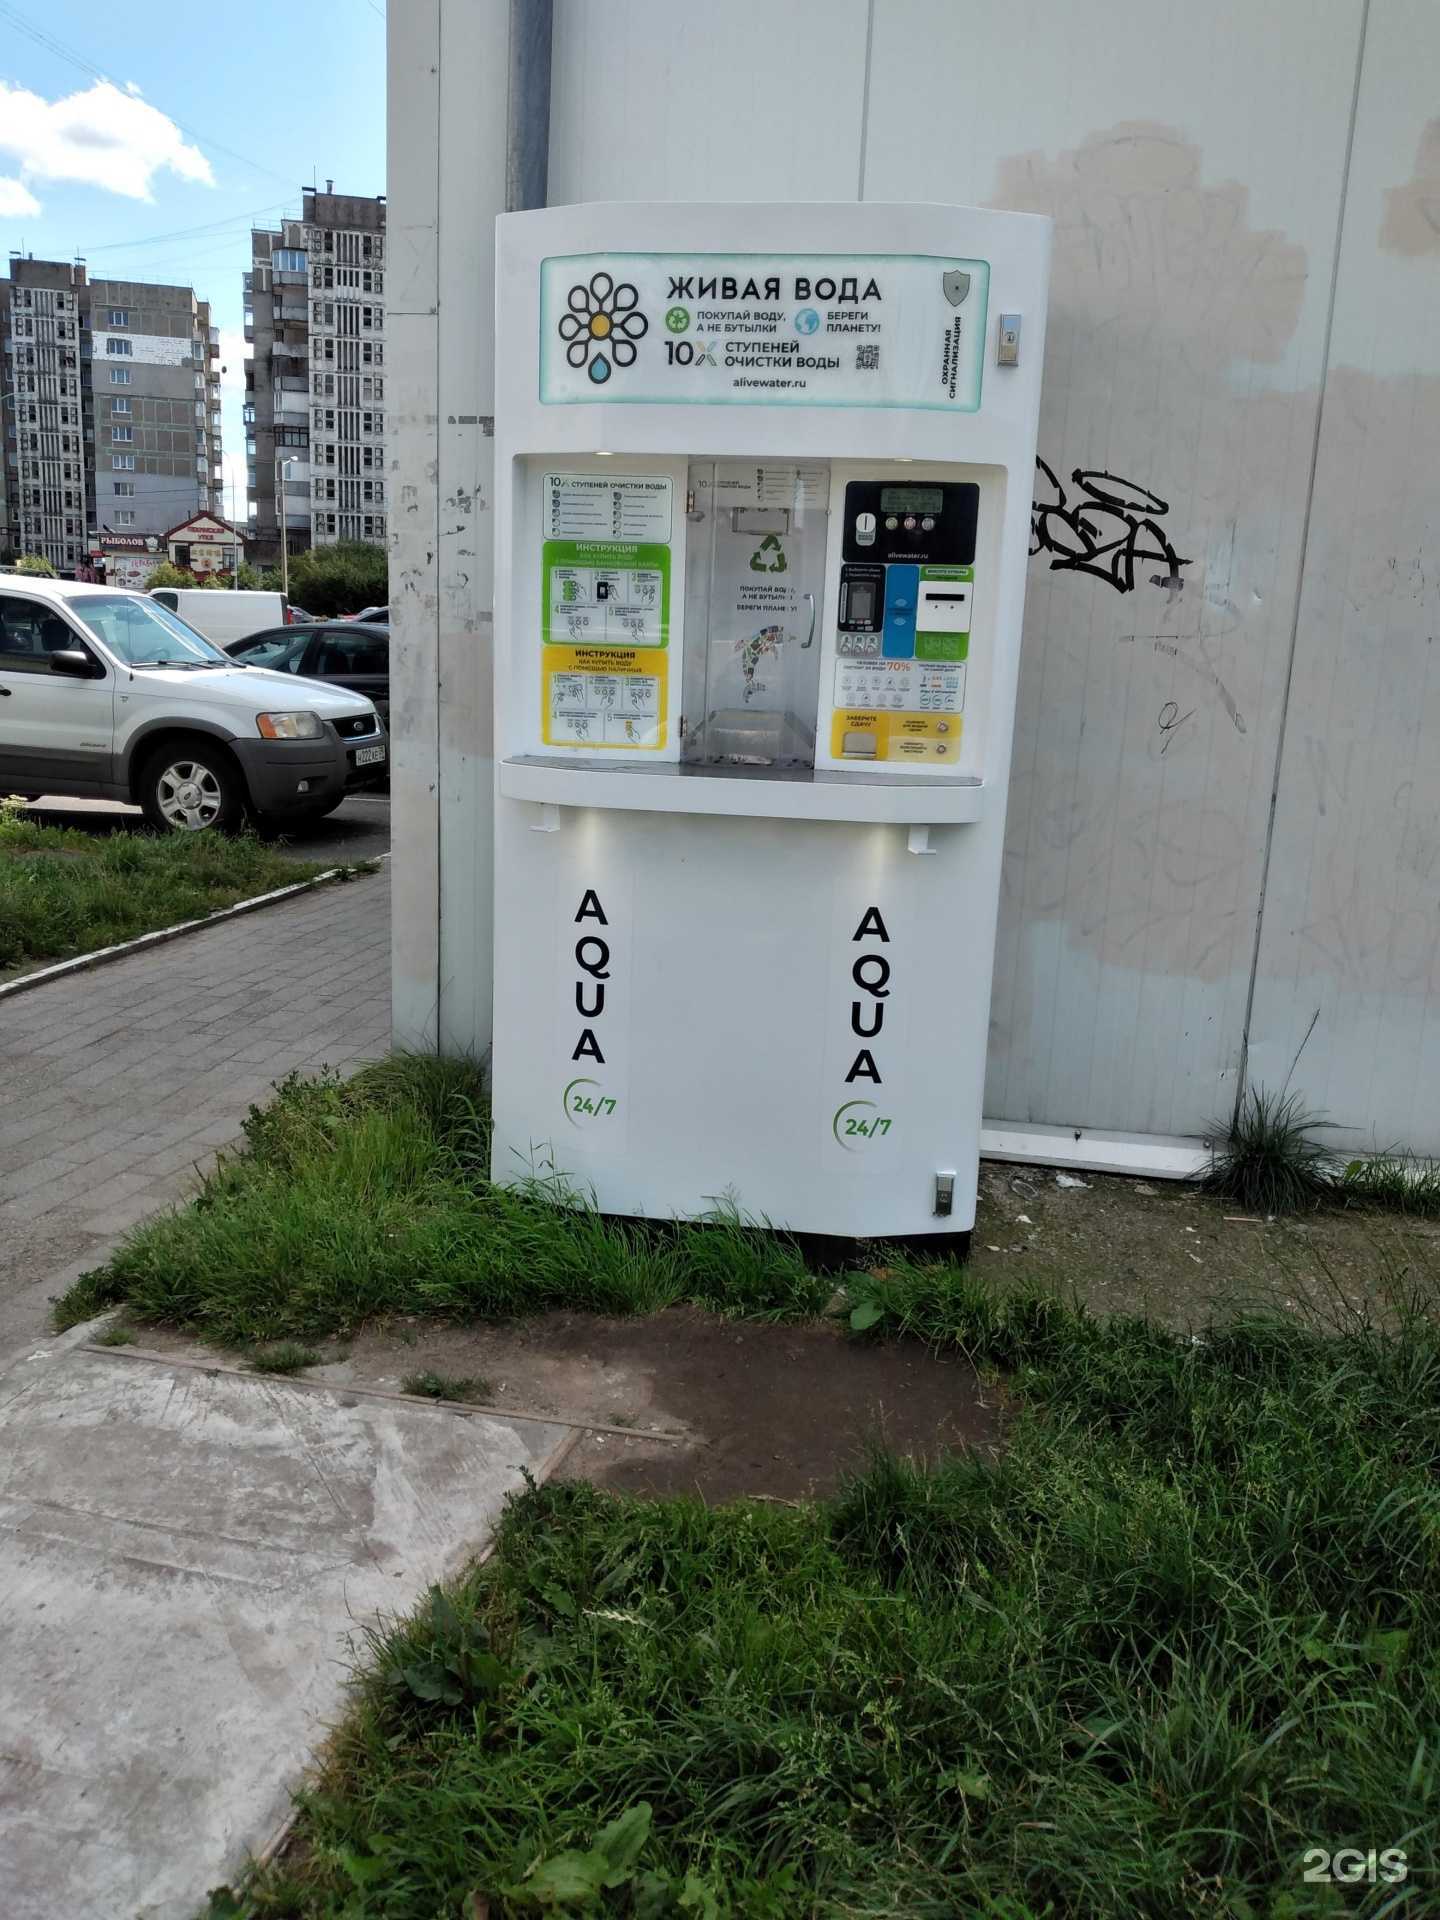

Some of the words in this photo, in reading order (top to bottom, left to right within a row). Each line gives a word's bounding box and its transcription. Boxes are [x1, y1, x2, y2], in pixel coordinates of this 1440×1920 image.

[666, 276, 781, 300] ЖИВАЯ
[794, 277, 882, 304] ВОДА
[697, 310, 751, 320] ПОКУПАЙ
[753, 311, 786, 322] ВОДУ,
[827, 311, 869, 321] БЕРЕГИ
[696, 324, 704, 332] А
[707, 324, 722, 333] НЕ
[724, 323, 777, 333] БУТЫЛКИ
[826, 323, 881, 333] ПЛАНЕТУ!
[725, 340, 800, 354] СТУПЕНЕЙ
[725, 356, 792, 368] ОЧИСТКИ
[796, 357, 840, 369] ВОДЫ
[941, 329, 952, 385] ОХРАННАЯ
[949, 316, 962, 399] СИГНАЛИЗАЦИЯ
[733, 377, 807, 388] alivewater.ru
[571, 481, 609, 489] СТУПЕНЕЙ
[610, 482, 644, 490] ОЧИСТКИ
[101, 536, 144, 546] РЫБОЛОВ
[576, 543, 638, 553] ИНСТРУКЦИЯ
[575, 649, 636, 659] ИНСТРУКЦИЯ
[886, 661, 911, 671] 70%
[572, 889, 611, 1064] AQUA
[844, 906, 891, 1084] AQUA
[573, 1095, 617, 1116] 24/7
[845, 1117, 892, 1139] 24/7
